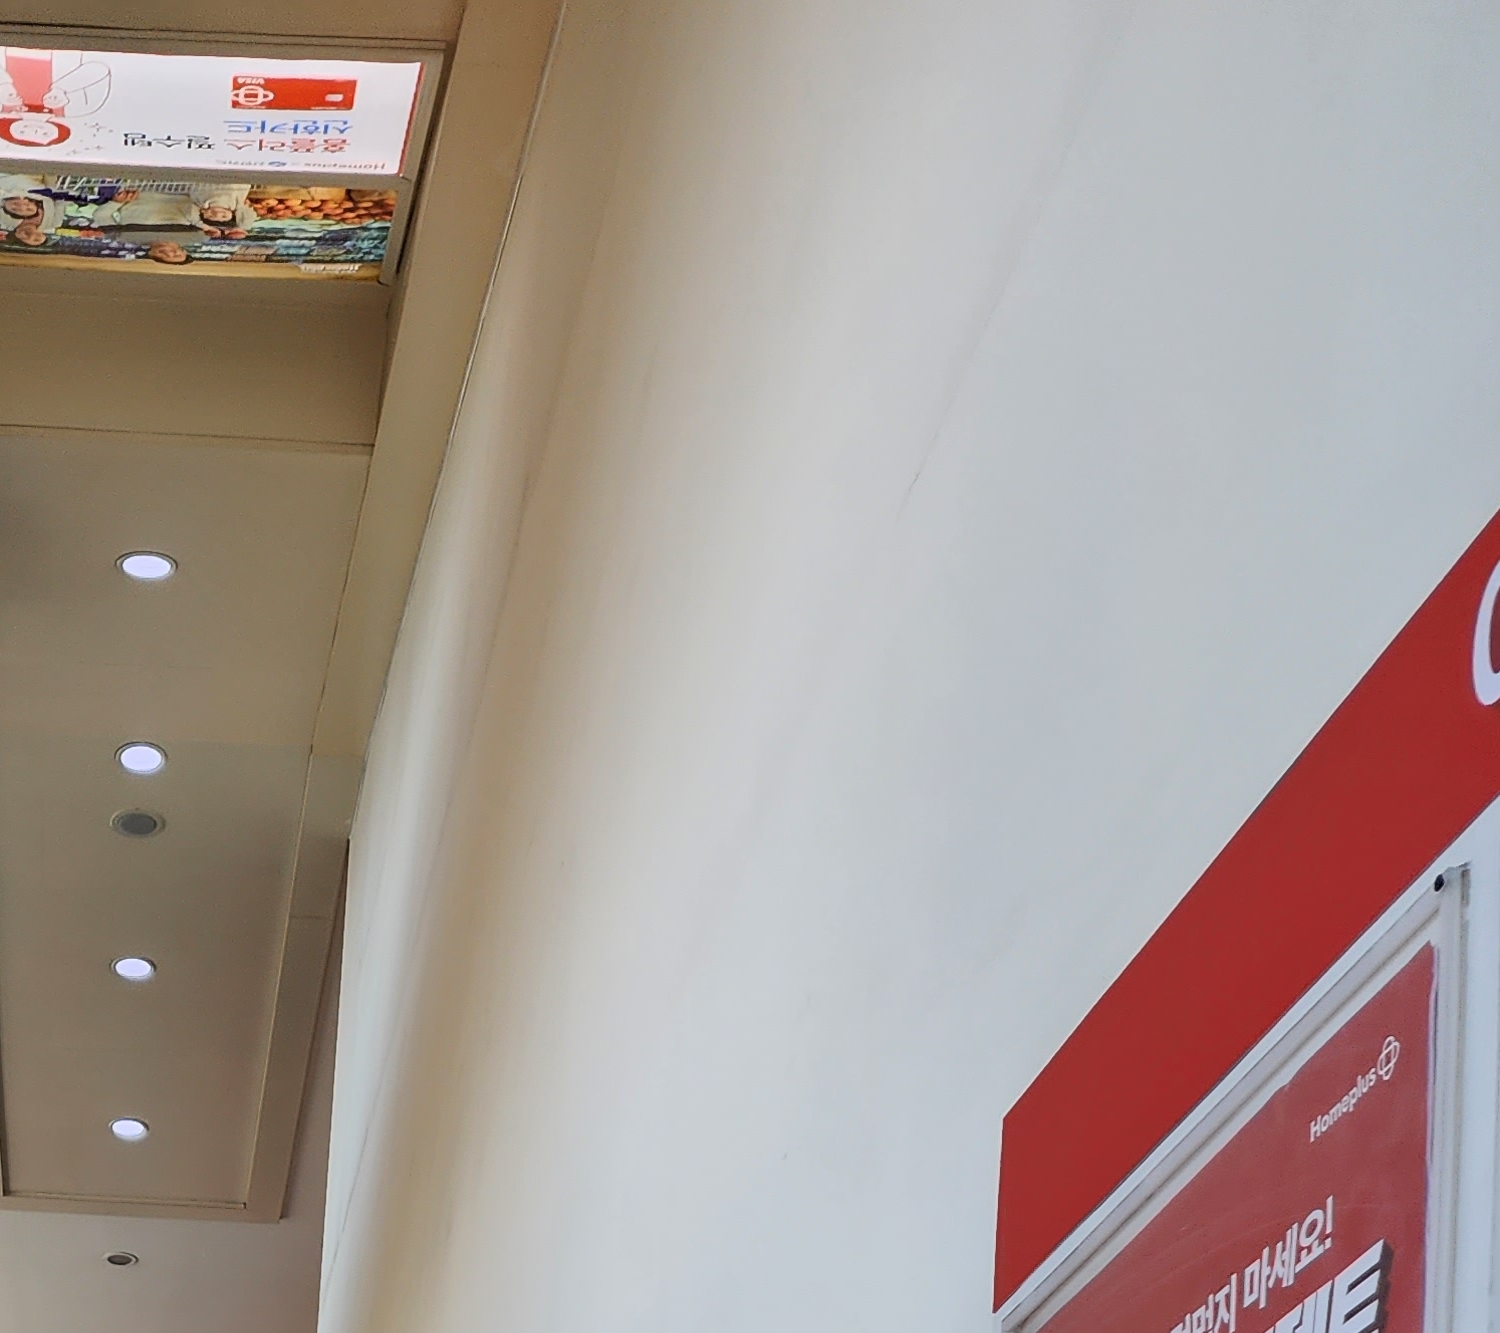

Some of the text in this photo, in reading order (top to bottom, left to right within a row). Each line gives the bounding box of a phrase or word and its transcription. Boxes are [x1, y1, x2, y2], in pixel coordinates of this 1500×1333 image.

[223, 120, 353, 135] 신한카드
[223, 138, 351, 153] 홈플러스
[1309, 1067, 1377, 1143] Homeplus
[1243, 1195, 1334, 1309] 마세요!
